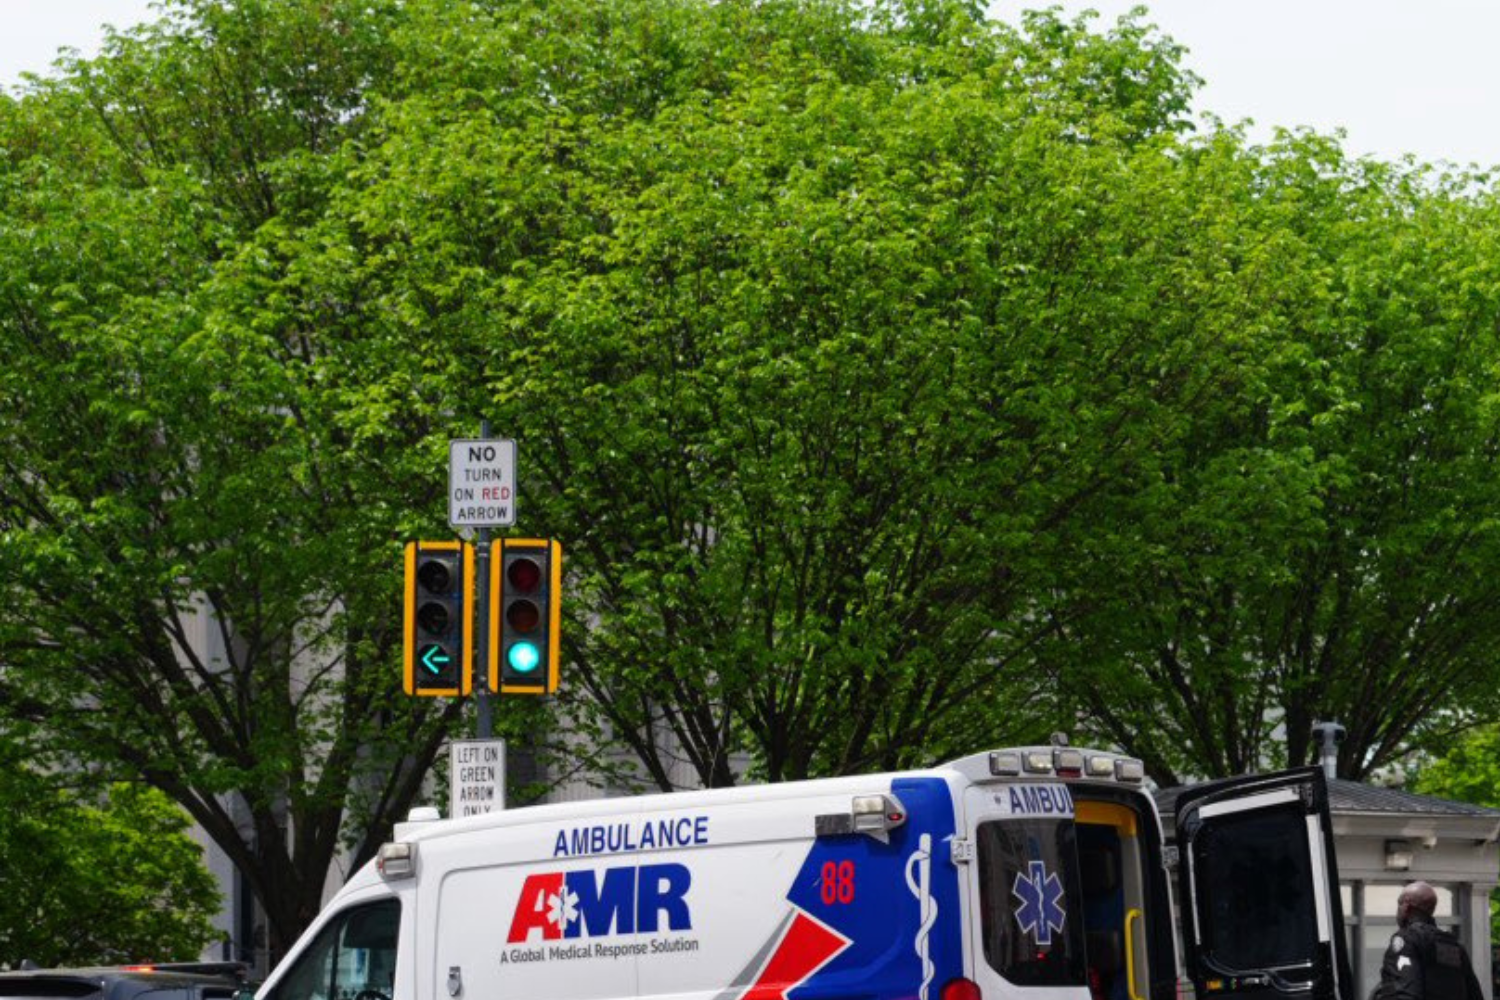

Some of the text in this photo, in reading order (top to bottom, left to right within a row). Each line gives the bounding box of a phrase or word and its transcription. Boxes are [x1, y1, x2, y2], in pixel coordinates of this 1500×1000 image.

[469, 446, 496, 461] NO
[464, 468, 502, 481] TURN
[455, 486, 510, 502] ON RED
[458, 506, 507, 520] ARROW
[458, 747, 498, 763] LEFT ON
[461, 766, 495, 782] GREEN
[461, 786, 495, 801] ARROW
[1009, 786, 1075, 814] AMBUL
[553, 816, 709, 856] AMBULANCE
[821, 860, 856, 906] 88
[507, 862, 692, 943] AMR
[500, 936, 699, 964] A Global Medical Response Solution
